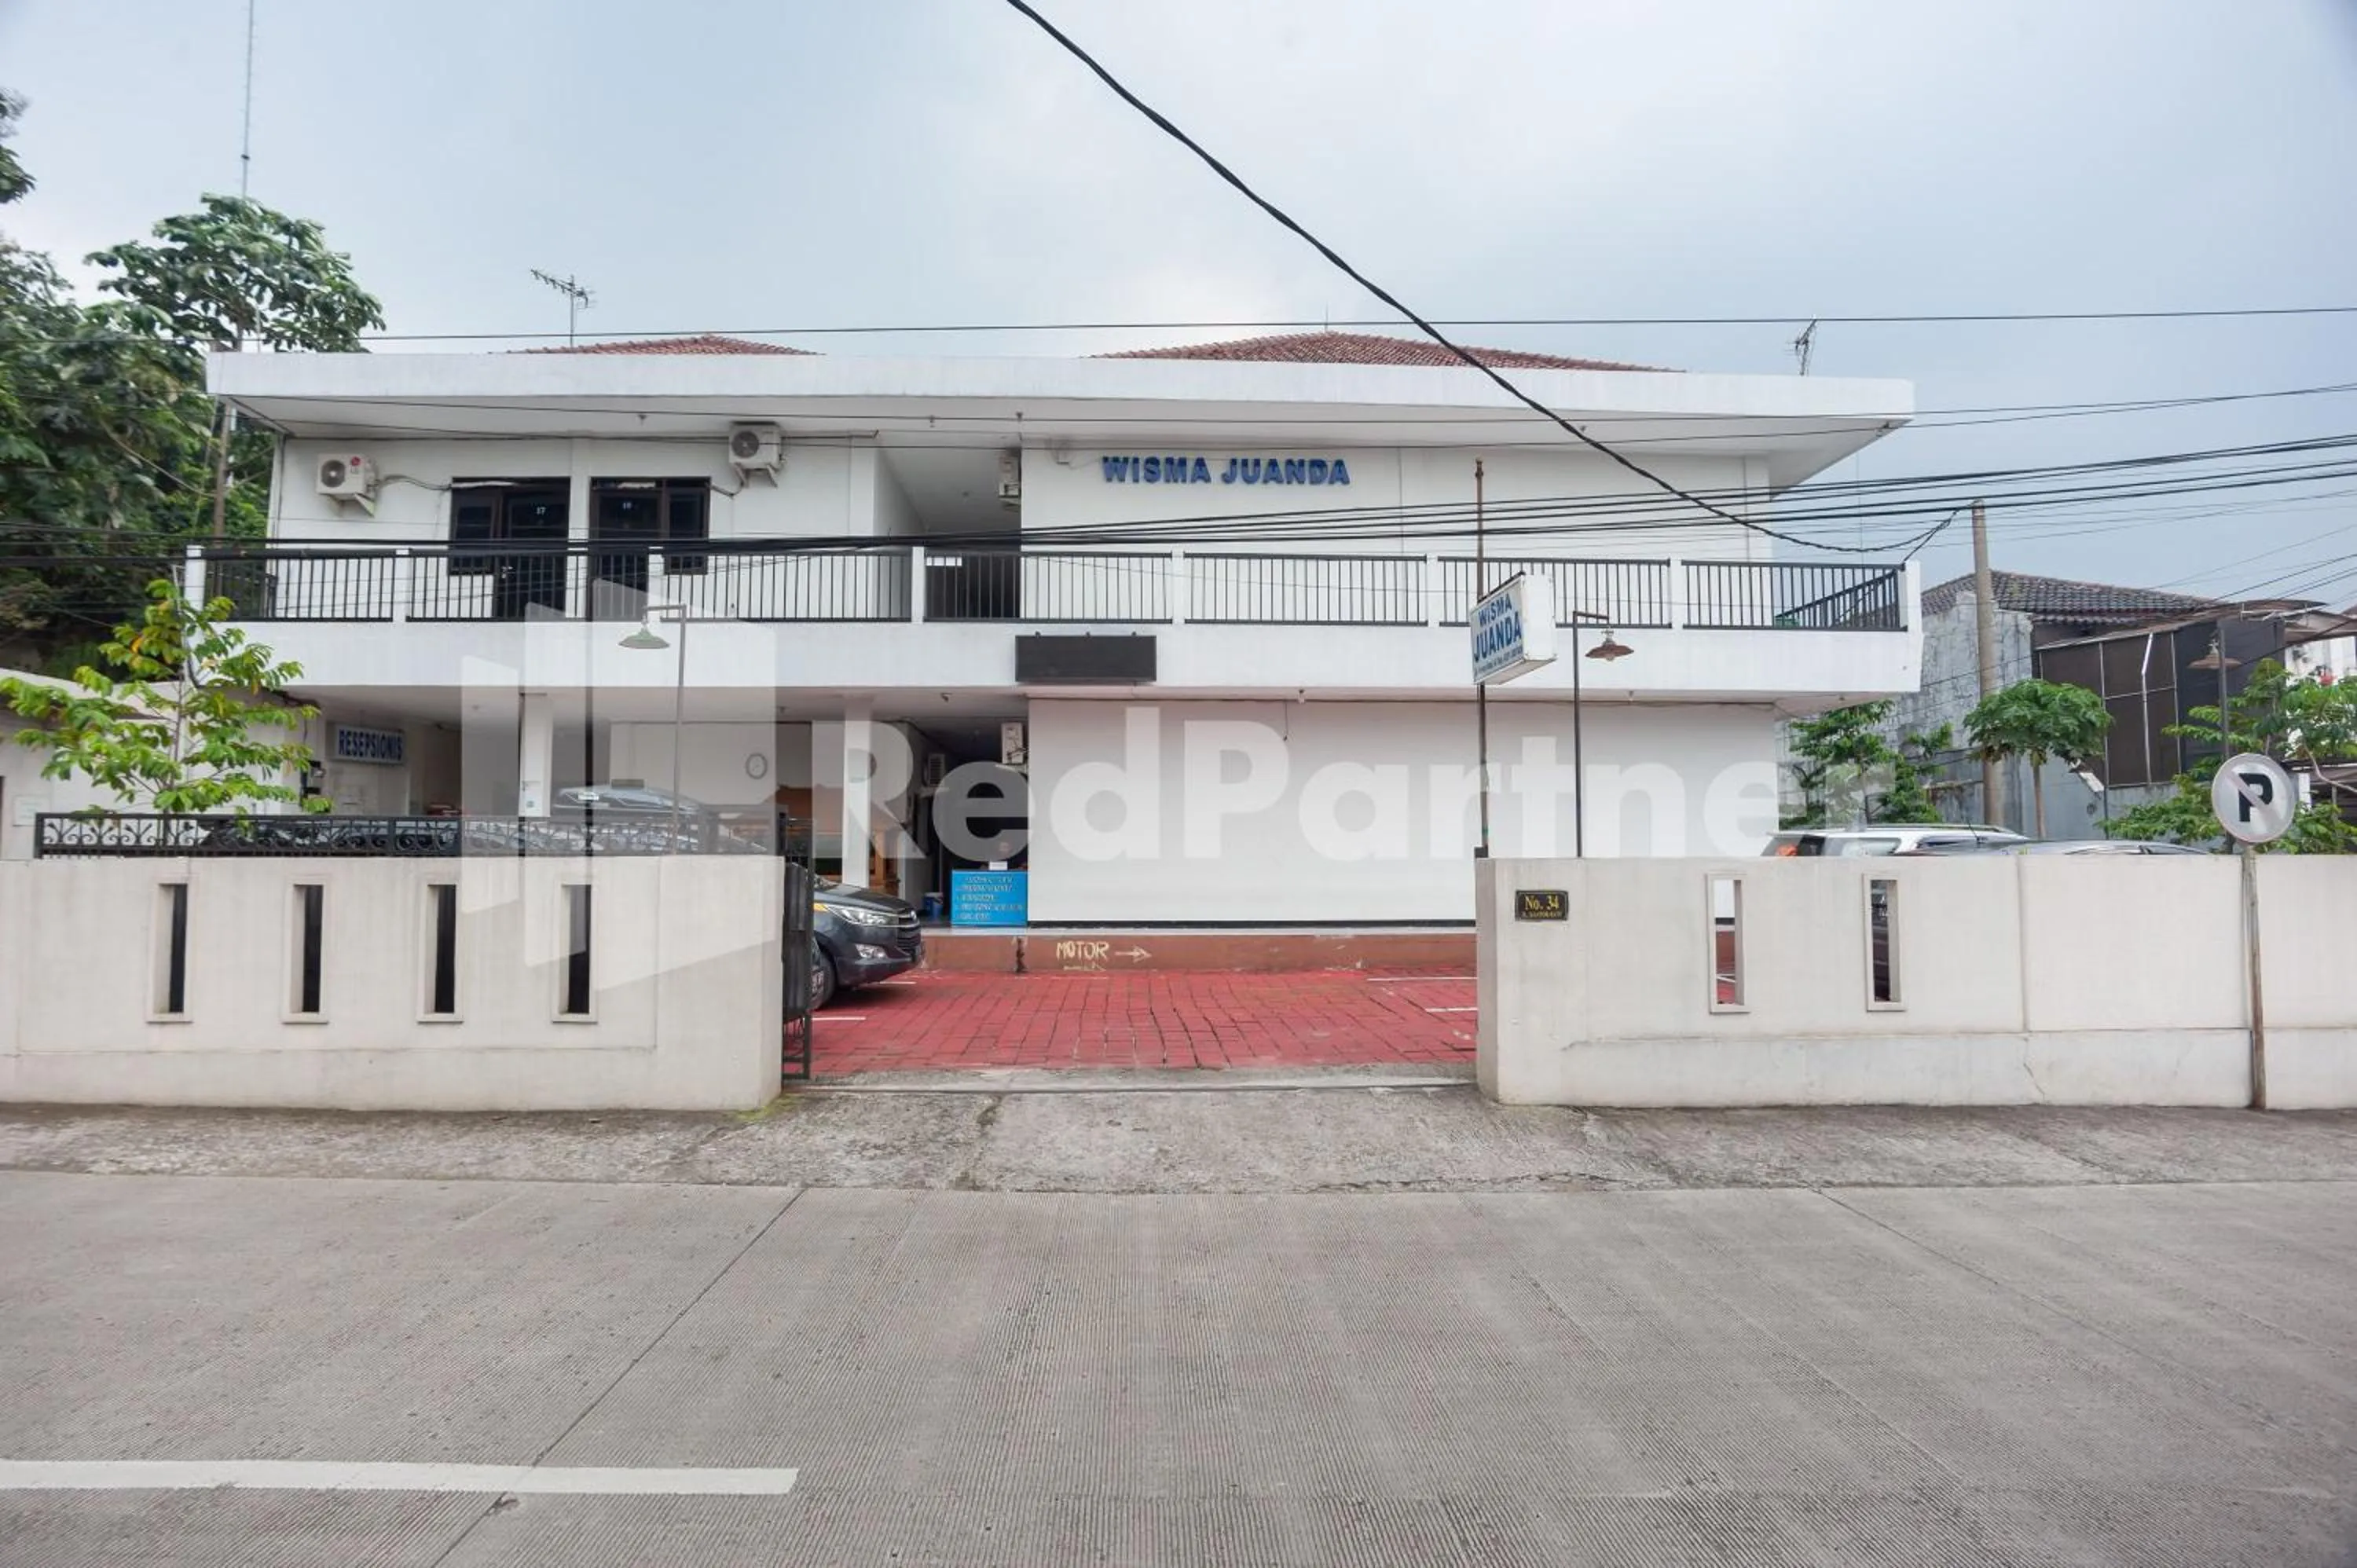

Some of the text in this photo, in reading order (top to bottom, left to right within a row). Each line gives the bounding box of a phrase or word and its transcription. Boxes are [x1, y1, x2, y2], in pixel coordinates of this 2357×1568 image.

[1102, 456, 1351, 485] WISMA JUANDA
[1473, 610, 1522, 662] JUANDA
[2238, 772, 2273, 822] P
[1055, 940, 1110, 961] MOTOR
